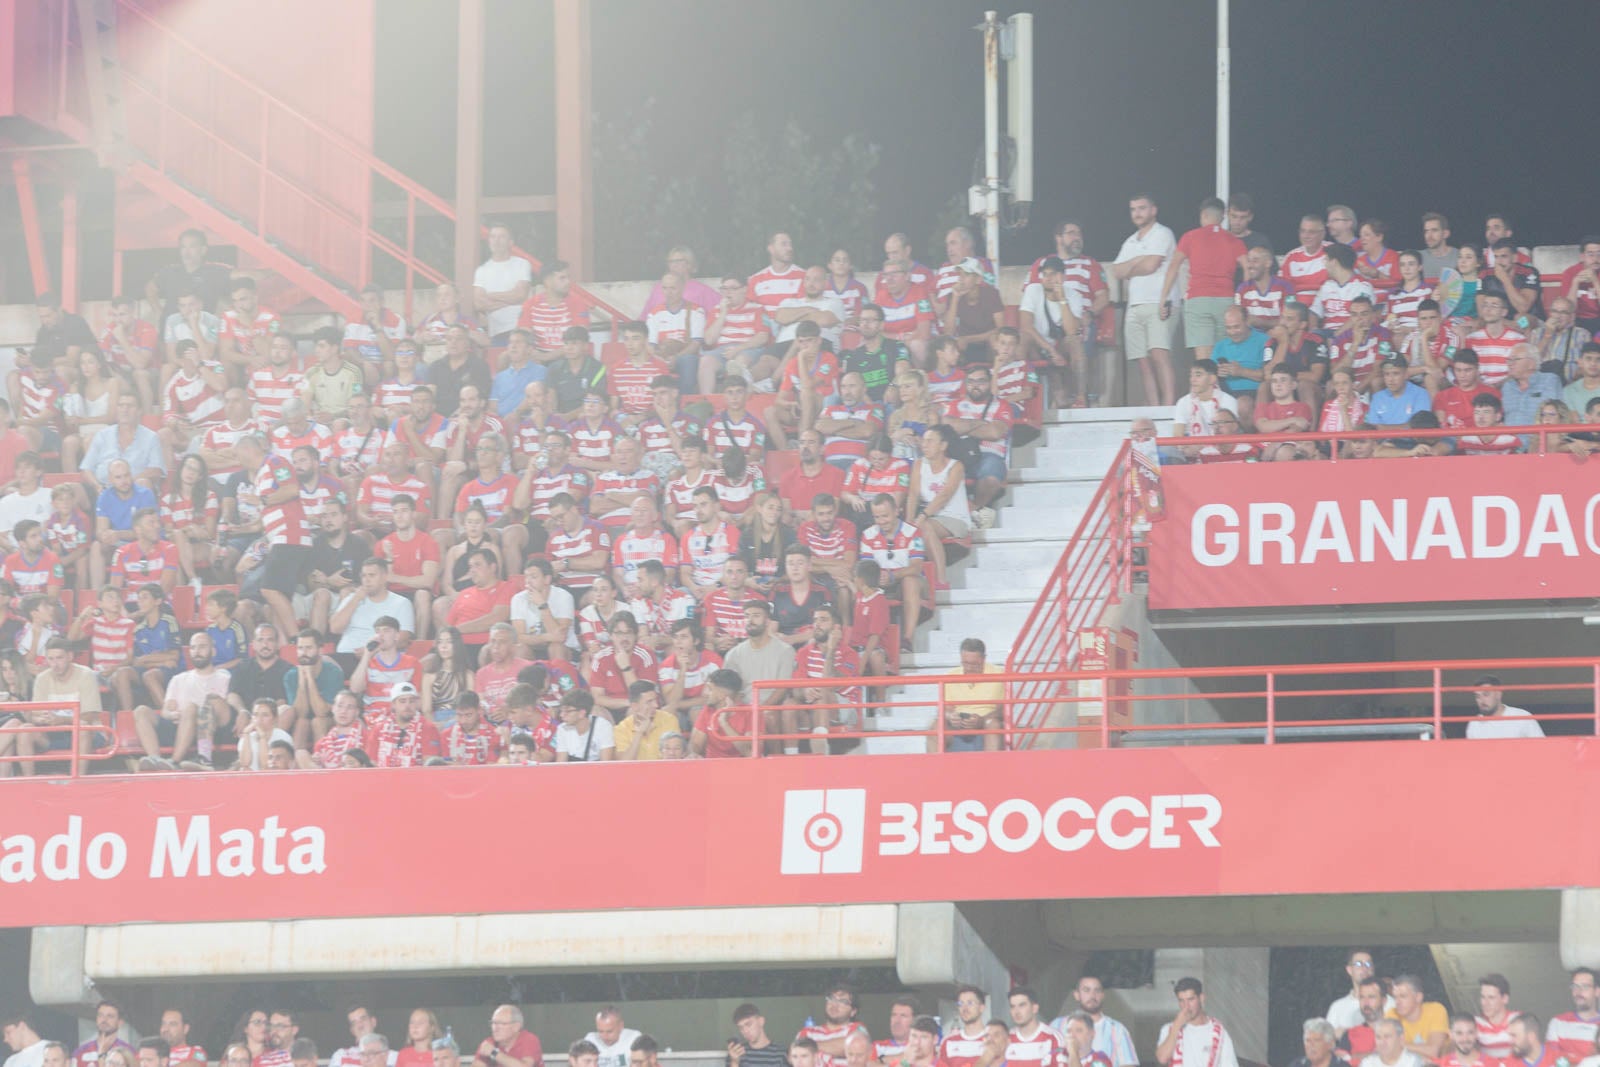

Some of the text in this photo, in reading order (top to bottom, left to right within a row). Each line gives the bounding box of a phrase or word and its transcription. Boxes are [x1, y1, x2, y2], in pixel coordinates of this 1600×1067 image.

[0, 814, 328, 883] ado Mata
[878, 793, 1223, 856] BESOCCER
